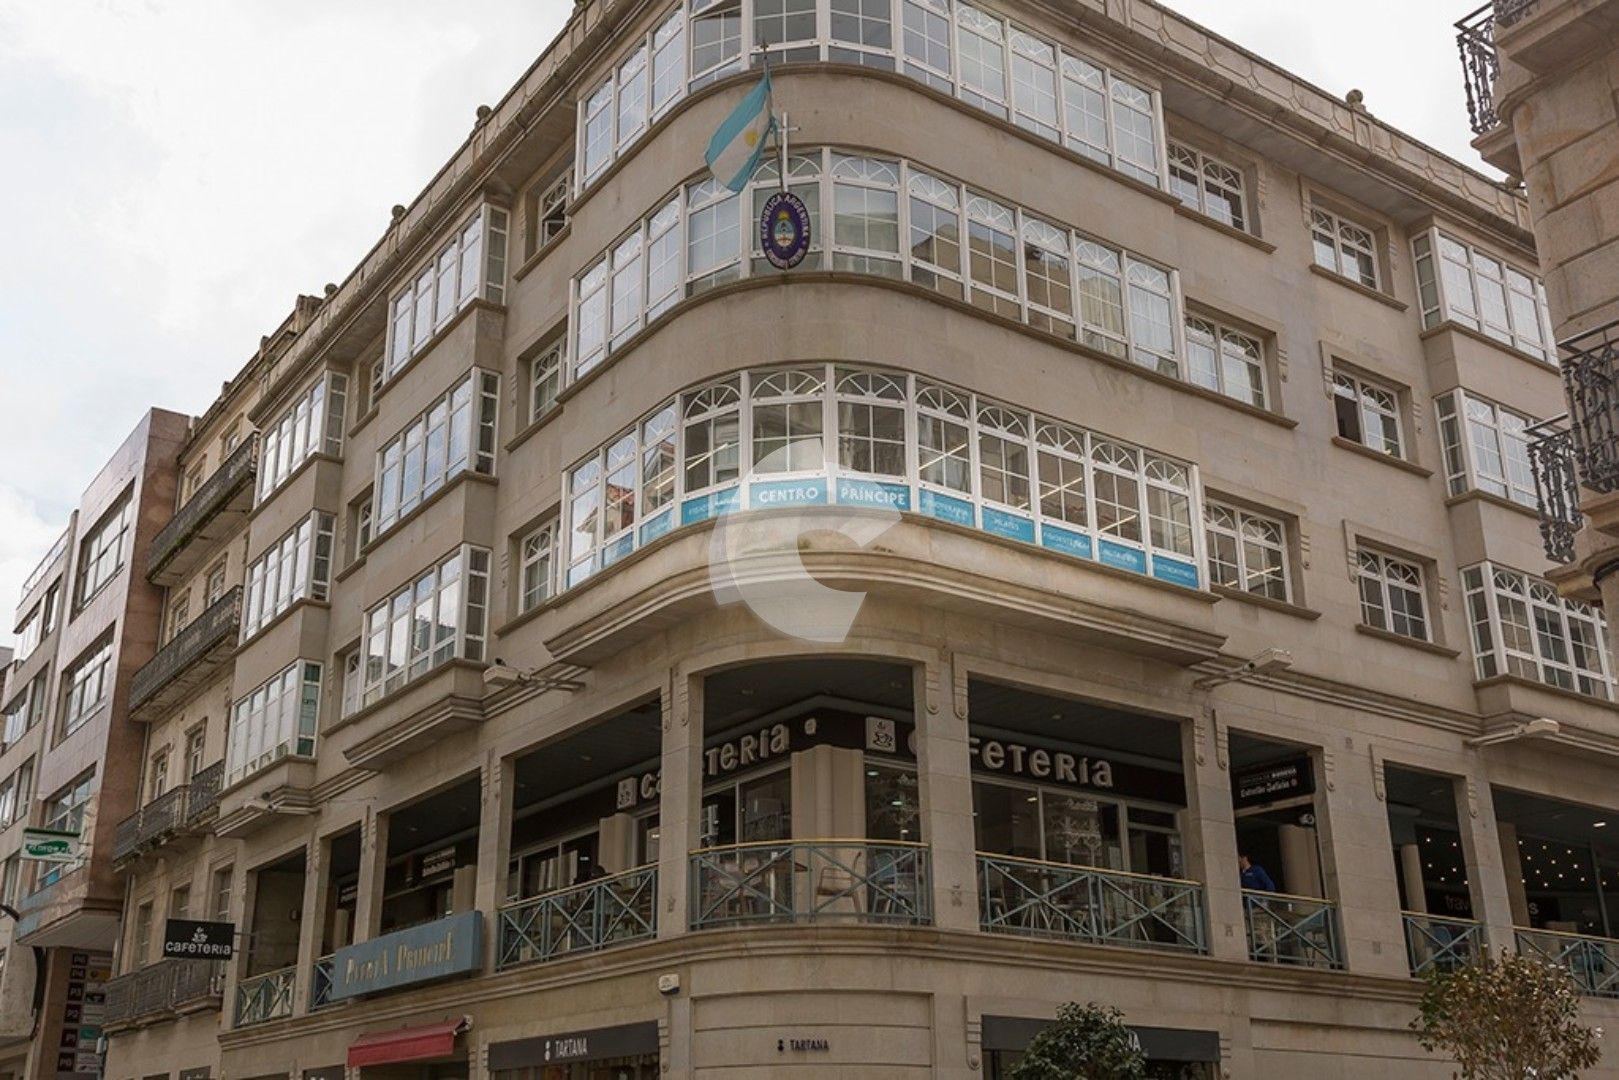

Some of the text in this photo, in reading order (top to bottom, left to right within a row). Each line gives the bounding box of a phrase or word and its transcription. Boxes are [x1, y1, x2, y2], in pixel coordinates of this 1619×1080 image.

[758, 486, 819, 504] CENTRO
[555, 1037, 589, 1058] TARTANA
[789, 1038, 830, 1052] TARTANA
